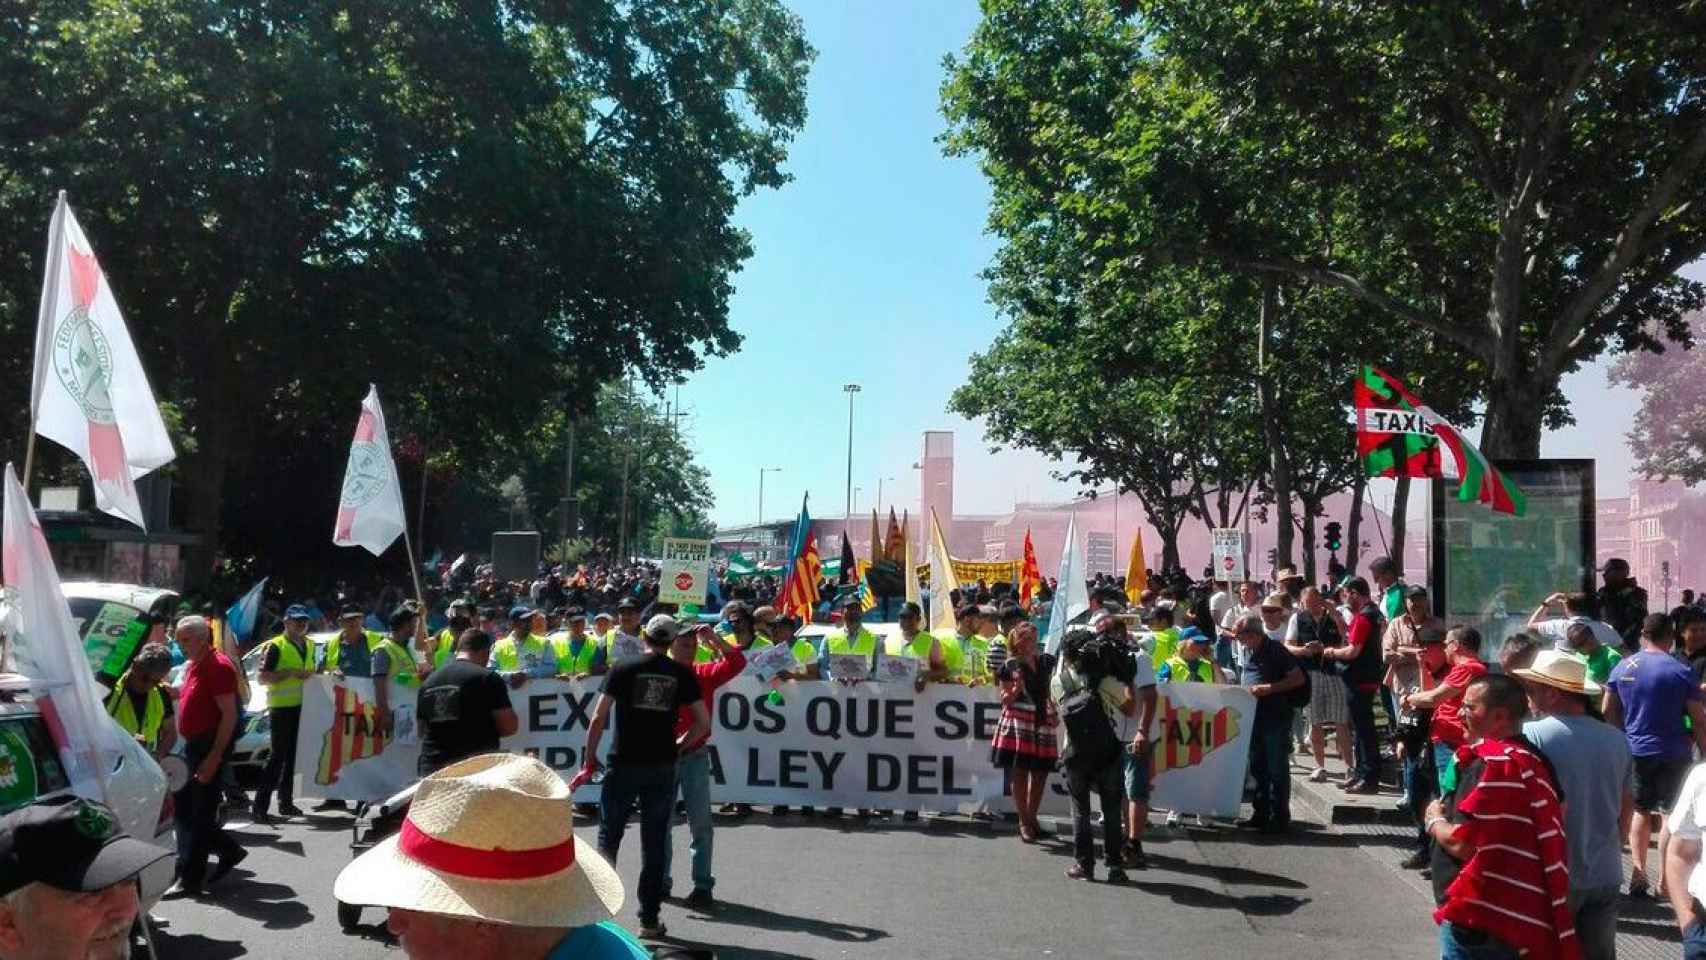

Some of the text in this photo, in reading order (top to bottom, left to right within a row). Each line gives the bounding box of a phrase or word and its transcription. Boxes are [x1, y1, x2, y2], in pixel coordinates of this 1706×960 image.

[806, 696, 915, 740] QUE
[747, 748, 846, 791] LEY
[867, 753, 972, 796] DEL
